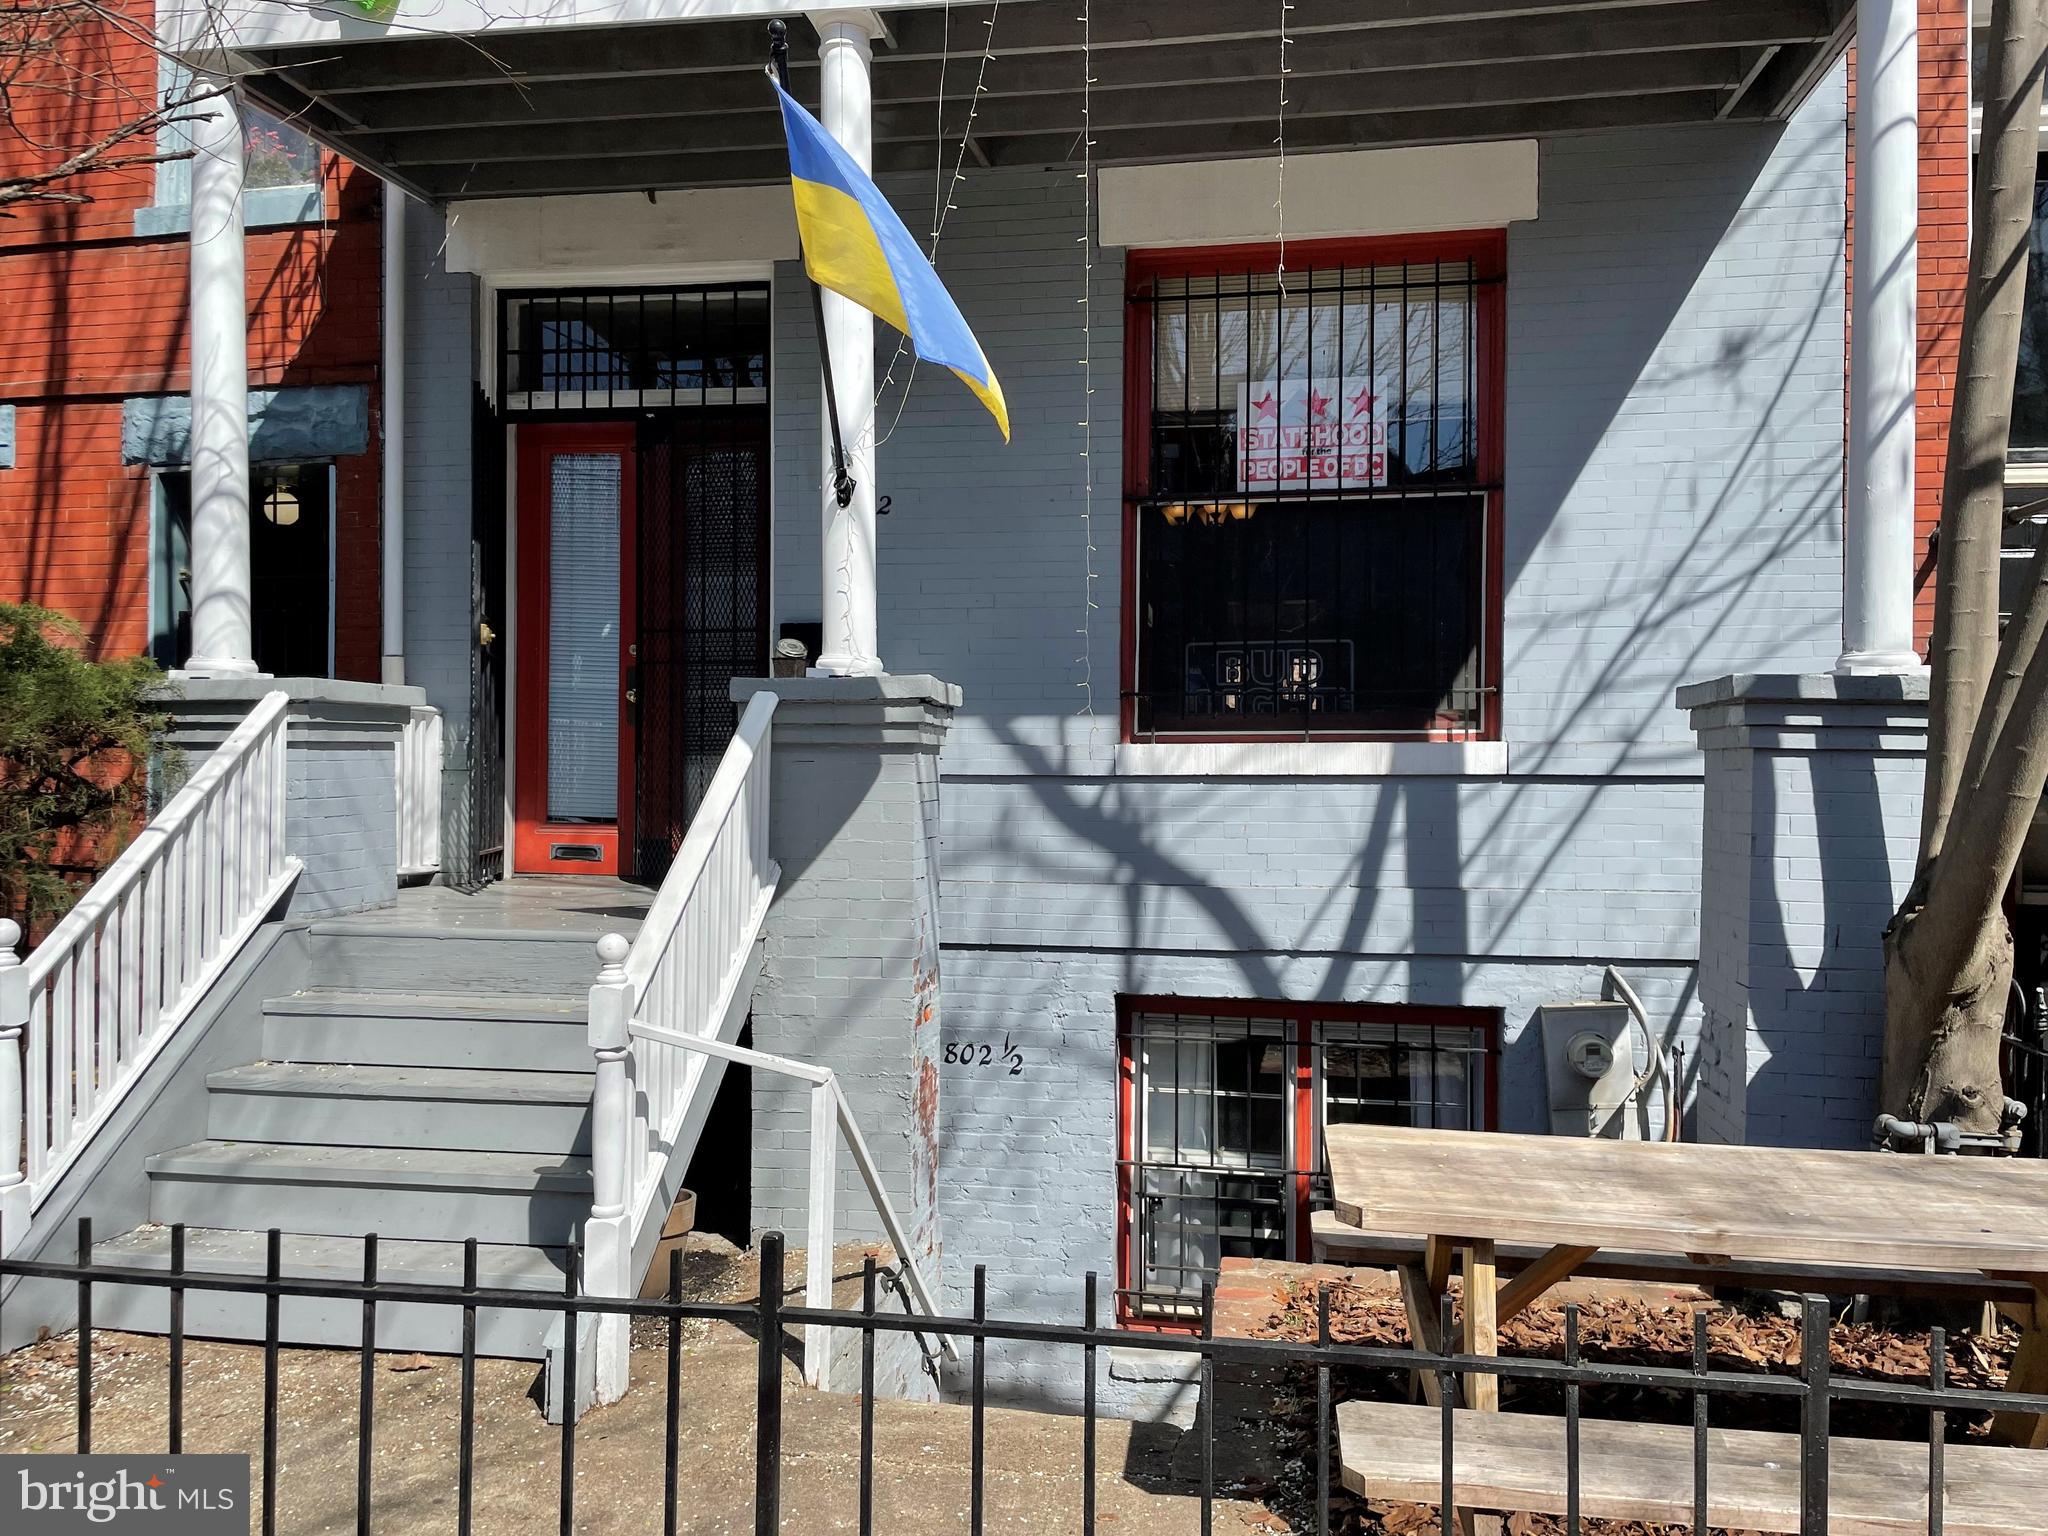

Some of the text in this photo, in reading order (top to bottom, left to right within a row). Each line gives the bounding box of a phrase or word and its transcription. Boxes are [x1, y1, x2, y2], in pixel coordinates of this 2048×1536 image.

[1246, 423, 1383, 450] STATEHOOD
[1316, 447, 1332, 455] the
[1245, 455, 1382, 480] PEOPLE OF DC
[876, 495, 892, 515] 2
[1216, 649, 1323, 686] BUD
[944, 1042, 992, 1066] 802
